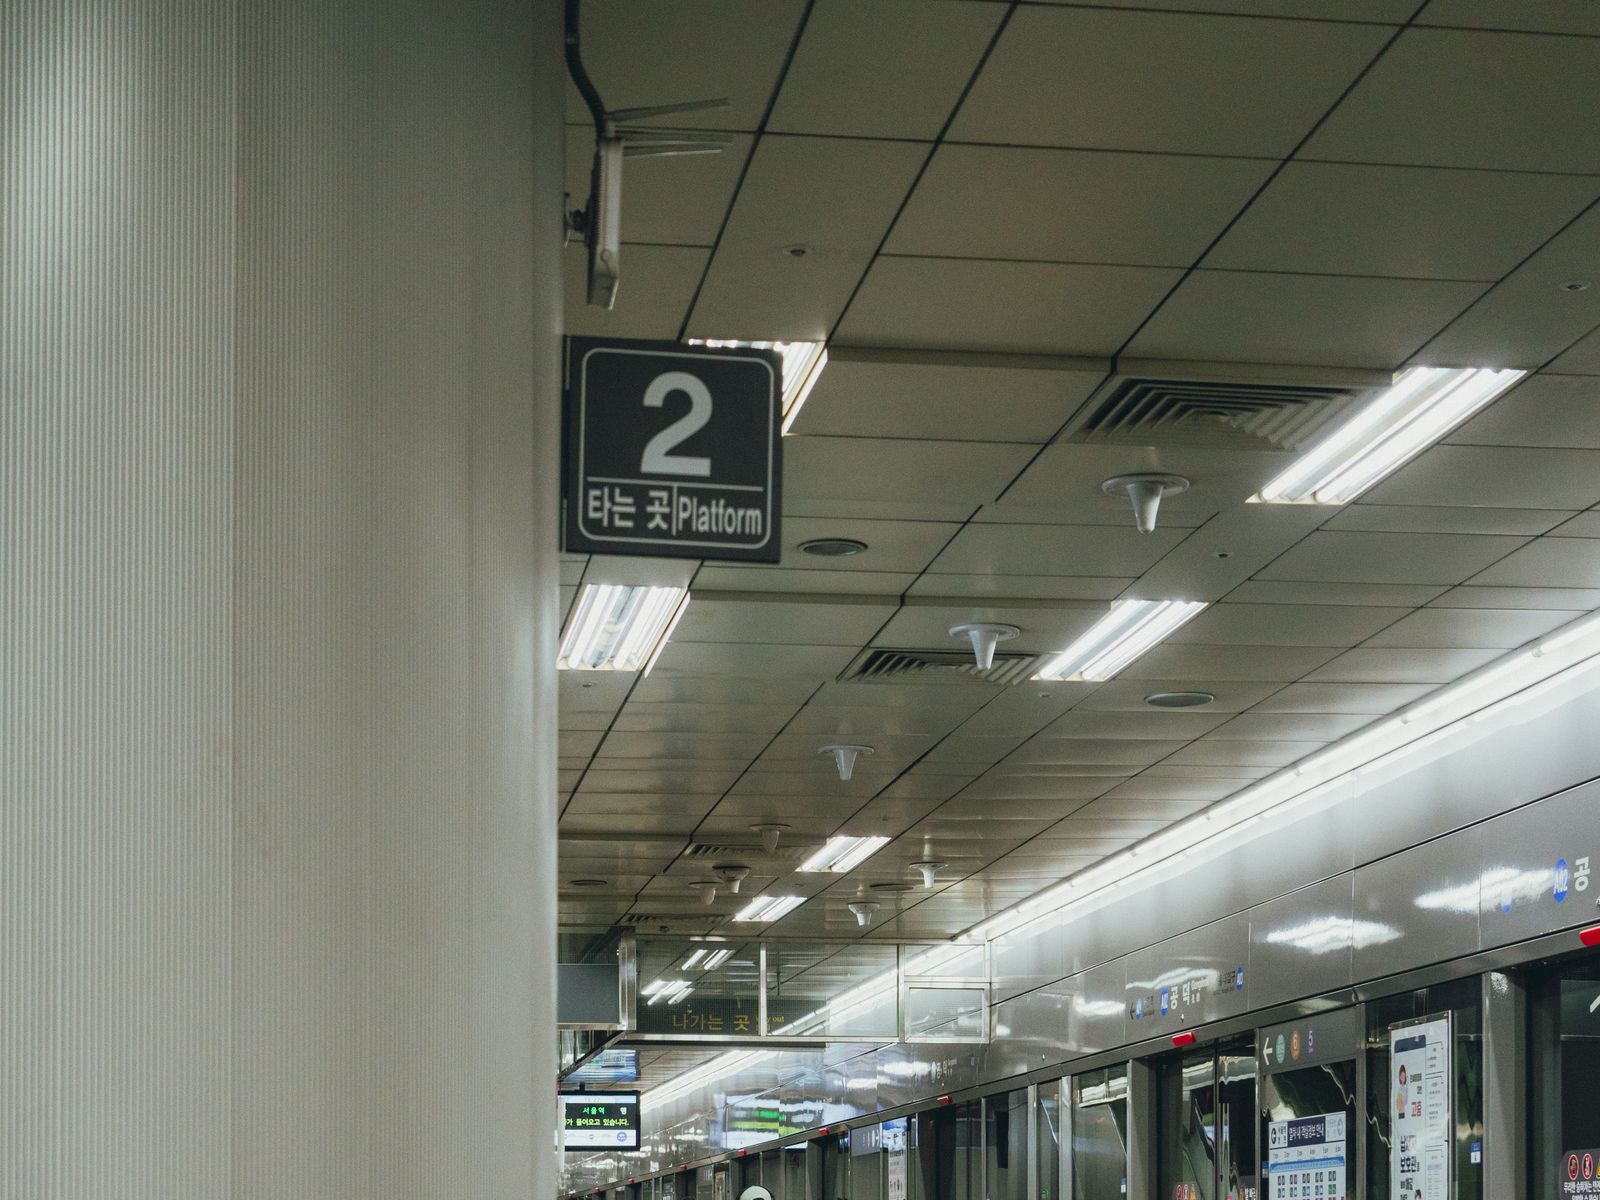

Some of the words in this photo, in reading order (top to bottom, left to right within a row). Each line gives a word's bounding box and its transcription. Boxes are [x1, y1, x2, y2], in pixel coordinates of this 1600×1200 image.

[640, 371, 712, 478] 2
[587, 486, 636, 528] 타는
[646, 490, 670, 531] 곳
[678, 494, 762, 536] Platform
[1574, 856, 1591, 892] 공
[1171, 986, 1178, 1010] 공
[1182, 981, 1190, 1005] 덕
[672, 1013, 724, 1031] 나가는
[733, 1014, 750, 1031] 곳
[1308, 1030, 1313, 1047] 5
[576, 1118, 601, 1126] 들어오고
[603, 1118, 629, 1126] 있습니다.
[582, 1106, 605, 1115] 서울역
